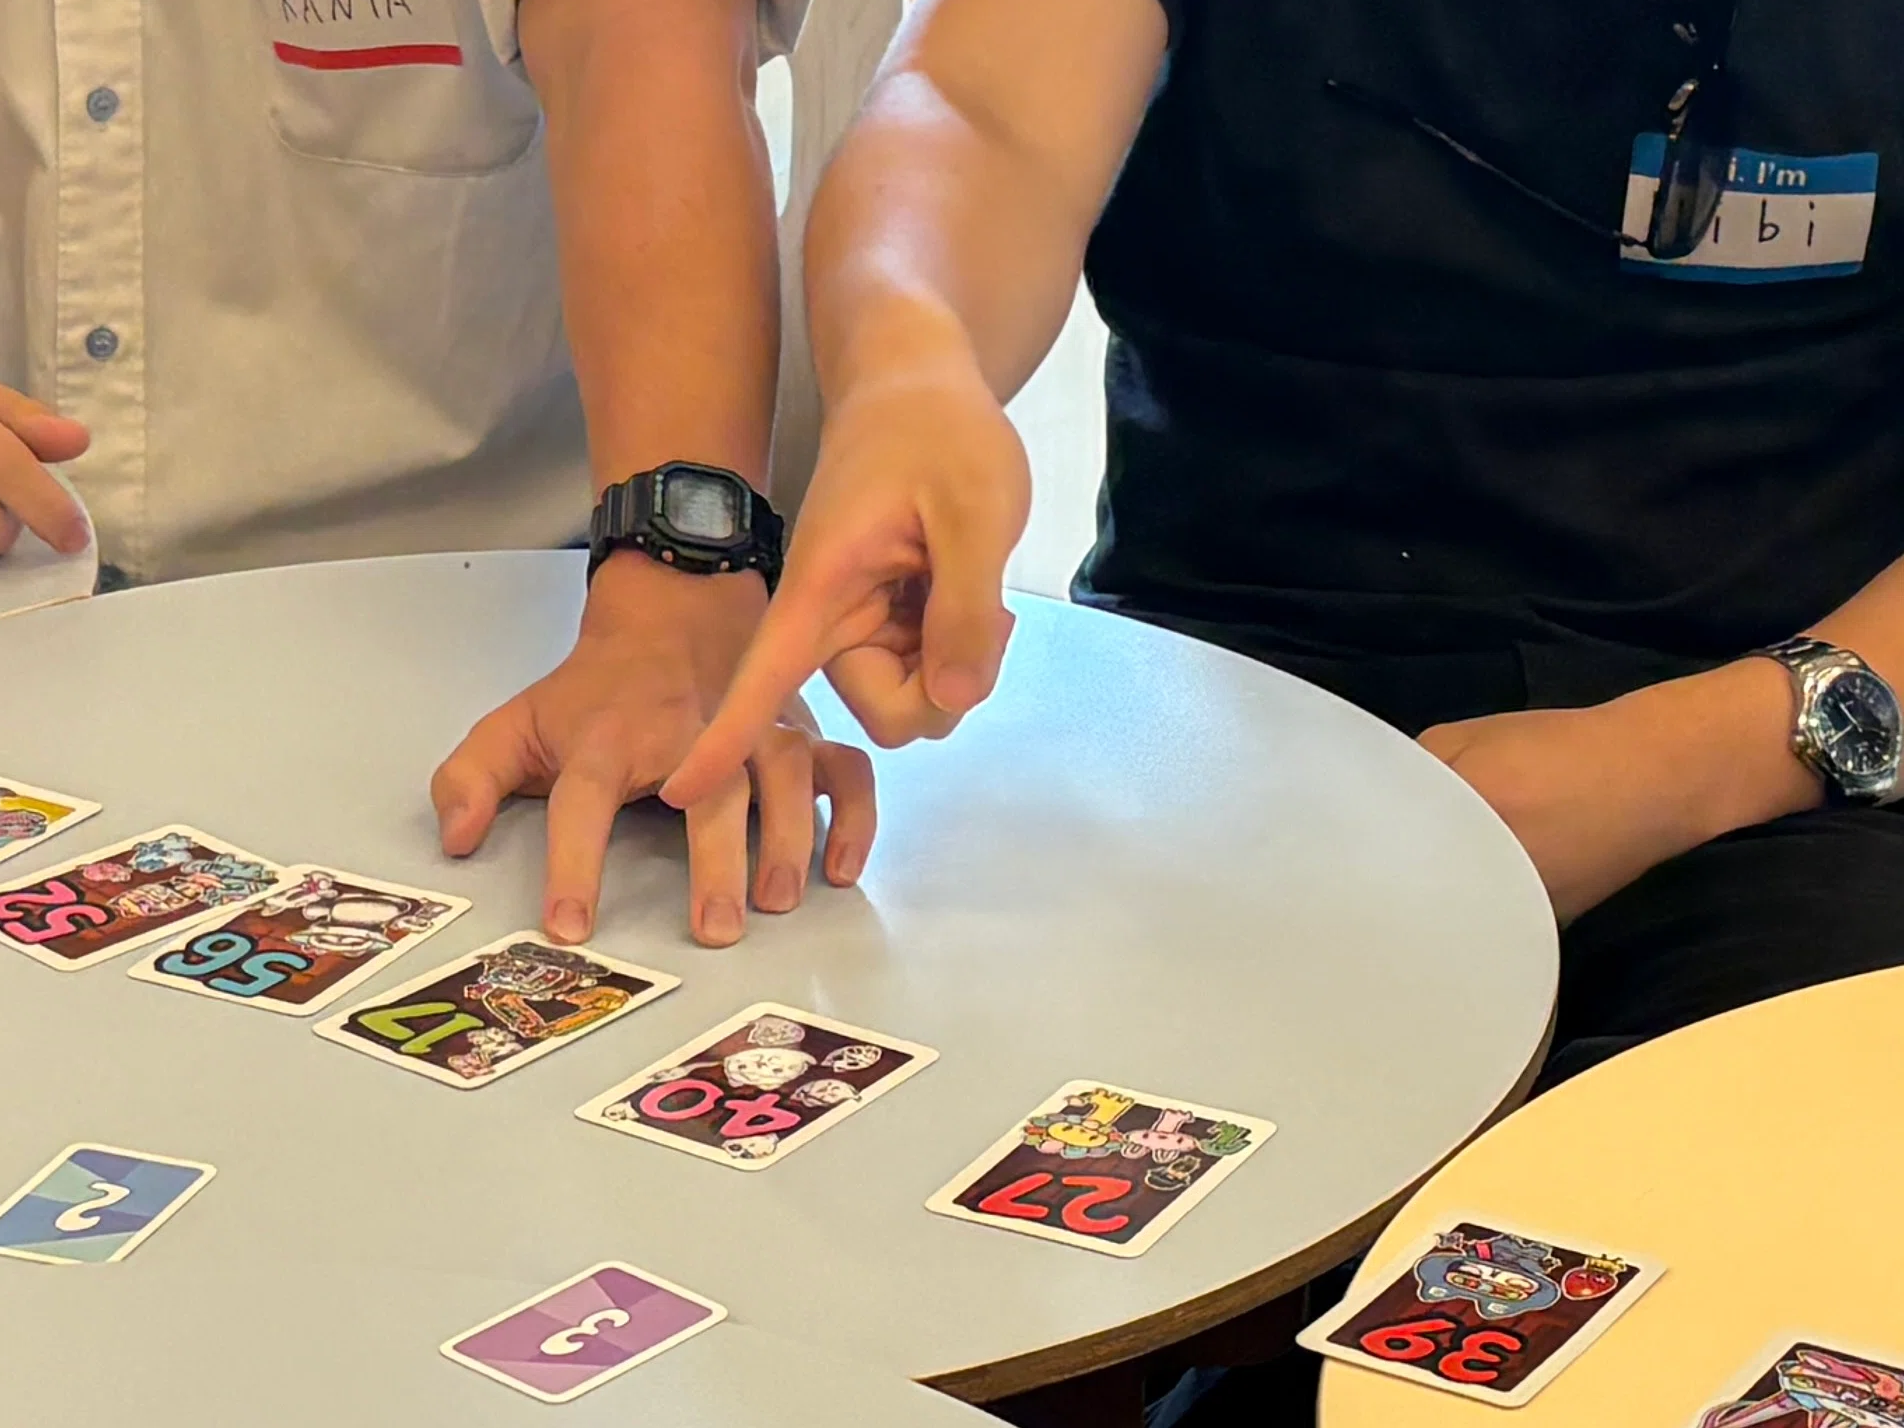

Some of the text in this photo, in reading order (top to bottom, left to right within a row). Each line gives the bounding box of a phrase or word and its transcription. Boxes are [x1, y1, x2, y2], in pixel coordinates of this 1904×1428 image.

[1757, 161, 1807, 188] I'm
[162, 932, 310, 996] 56
[358, 1002, 484, 1054] 17
[639, 1078, 801, 1138] 40
[54, 1182, 131, 1231] 2
[978, 1173, 1132, 1234] 27
[539, 1307, 631, 1356] 3
[1359, 1319, 1523, 1383] 39
